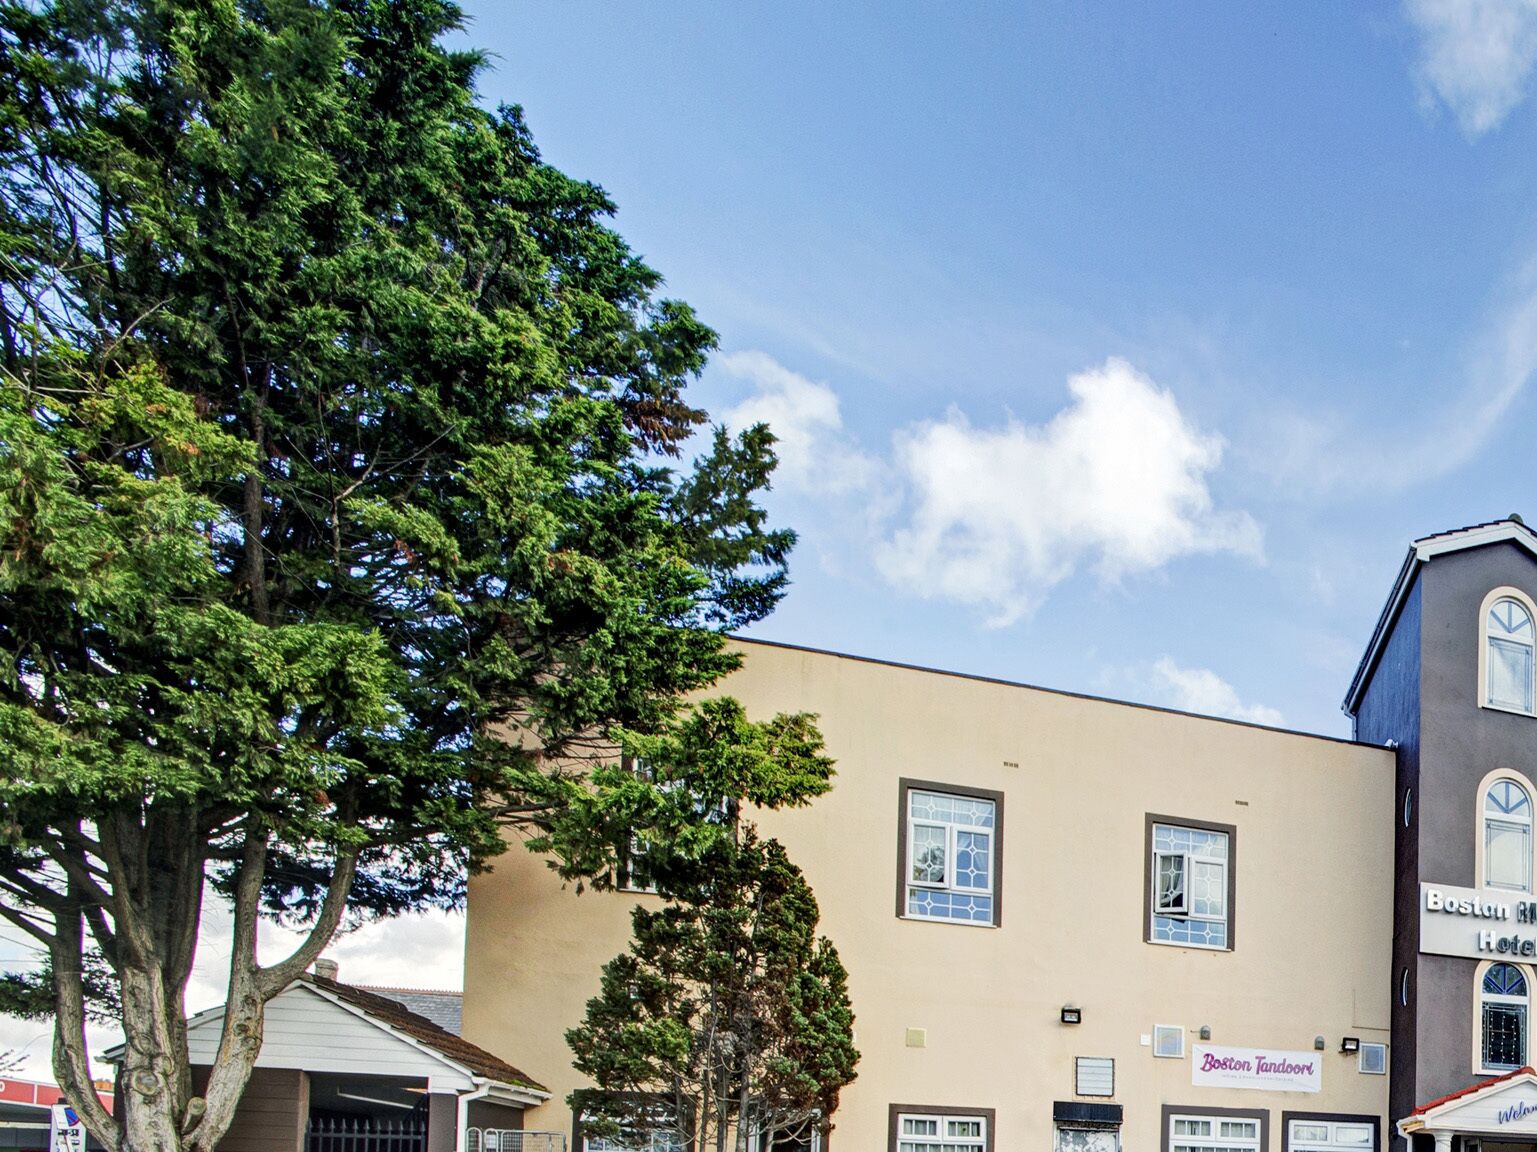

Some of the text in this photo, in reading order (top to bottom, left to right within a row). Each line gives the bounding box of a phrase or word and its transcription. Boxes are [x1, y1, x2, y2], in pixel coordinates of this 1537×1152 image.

[1426, 888, 1511, 921] Boston
[1200, 1053, 1315, 1076] Boston Tandoori
